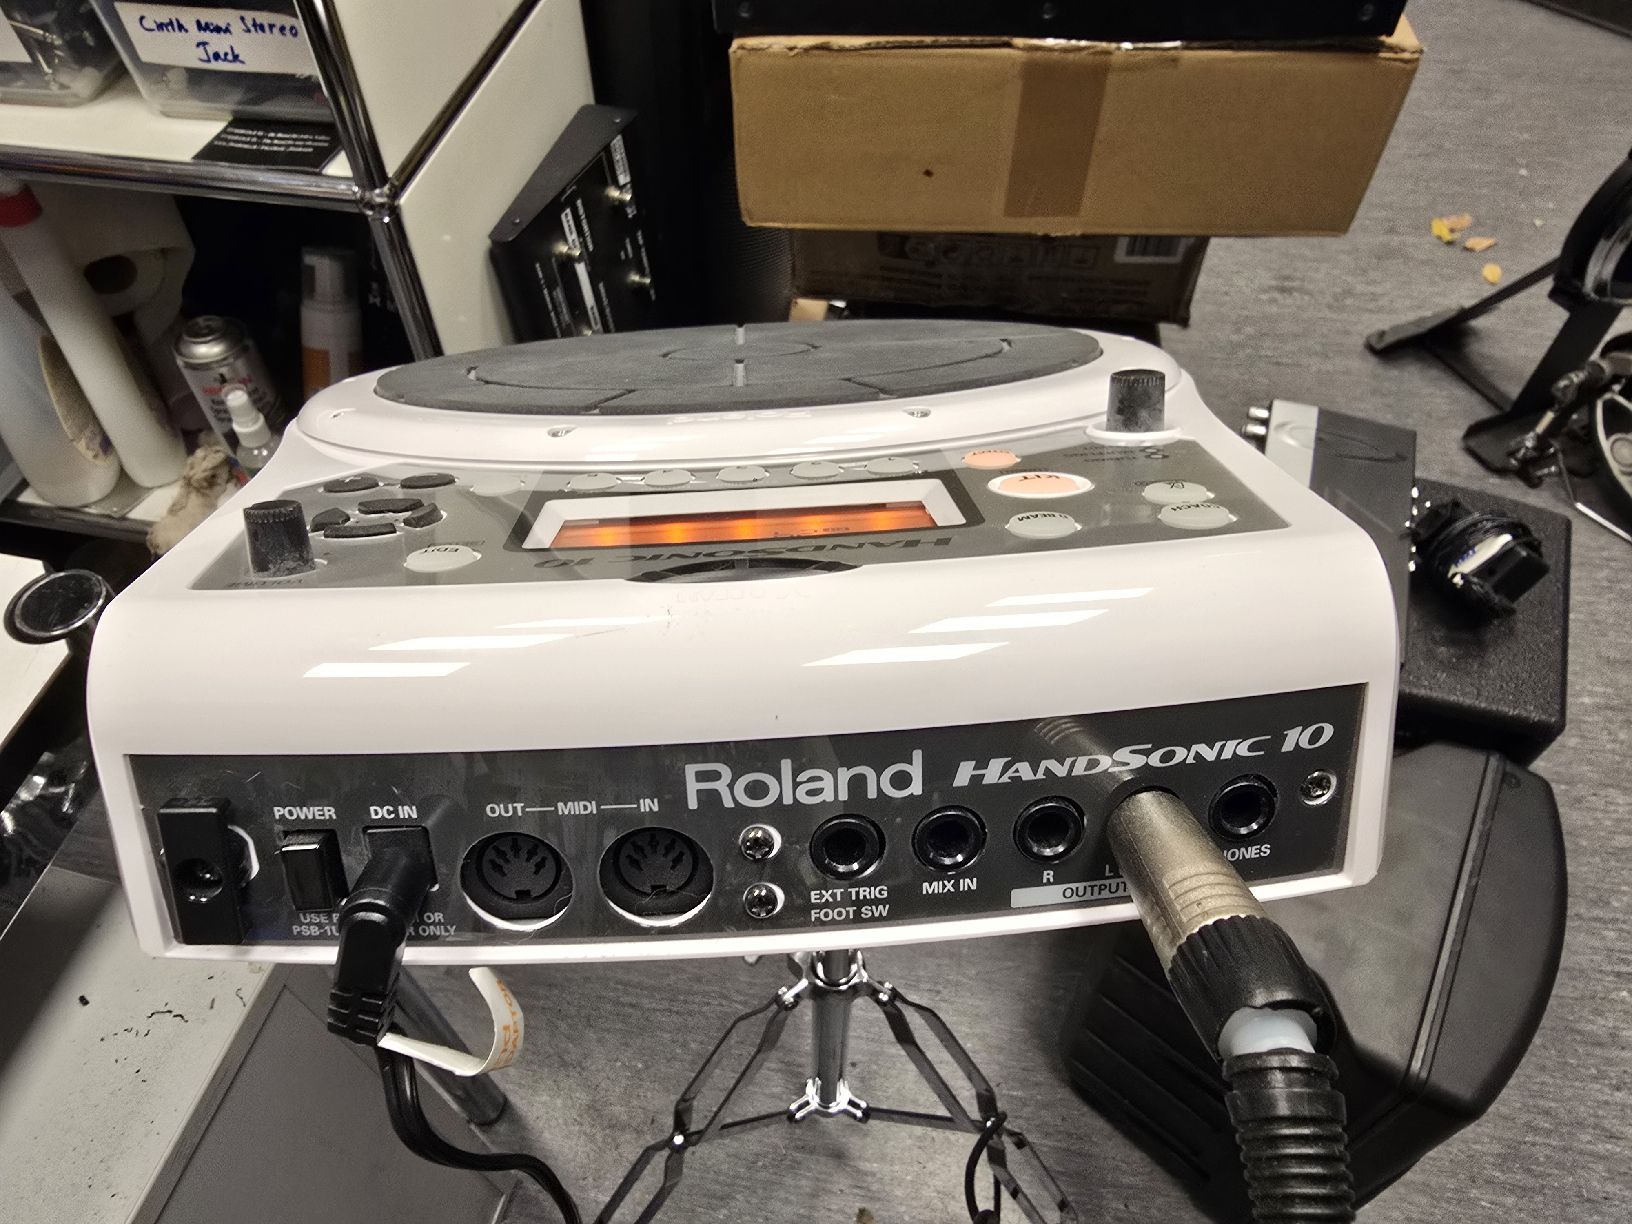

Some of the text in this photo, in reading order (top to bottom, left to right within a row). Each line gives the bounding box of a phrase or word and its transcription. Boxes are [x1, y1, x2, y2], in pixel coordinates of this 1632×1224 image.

[240, 15, 299, 38] Stereo
[196, 41, 246, 64] Jack
[1280, 722, 1335, 754] 10
[684, 748, 923, 810] Roland
[273, 806, 337, 820] POWER
[369, 805, 418, 819] DC IN
[485, 798, 659, 817] OUT MIDI IN
[922, 877, 978, 895] MIX IN
[1042, 870, 1054, 884] R
[810, 885, 888, 903] EXT TRIG
[1061, 880, 1127, 899] OUTPUT
[299, 912, 329, 923] USE
[423, 912, 444, 923] OR
[811, 904, 890, 922] FOOT SW
[418, 925, 456, 937] ONLY
